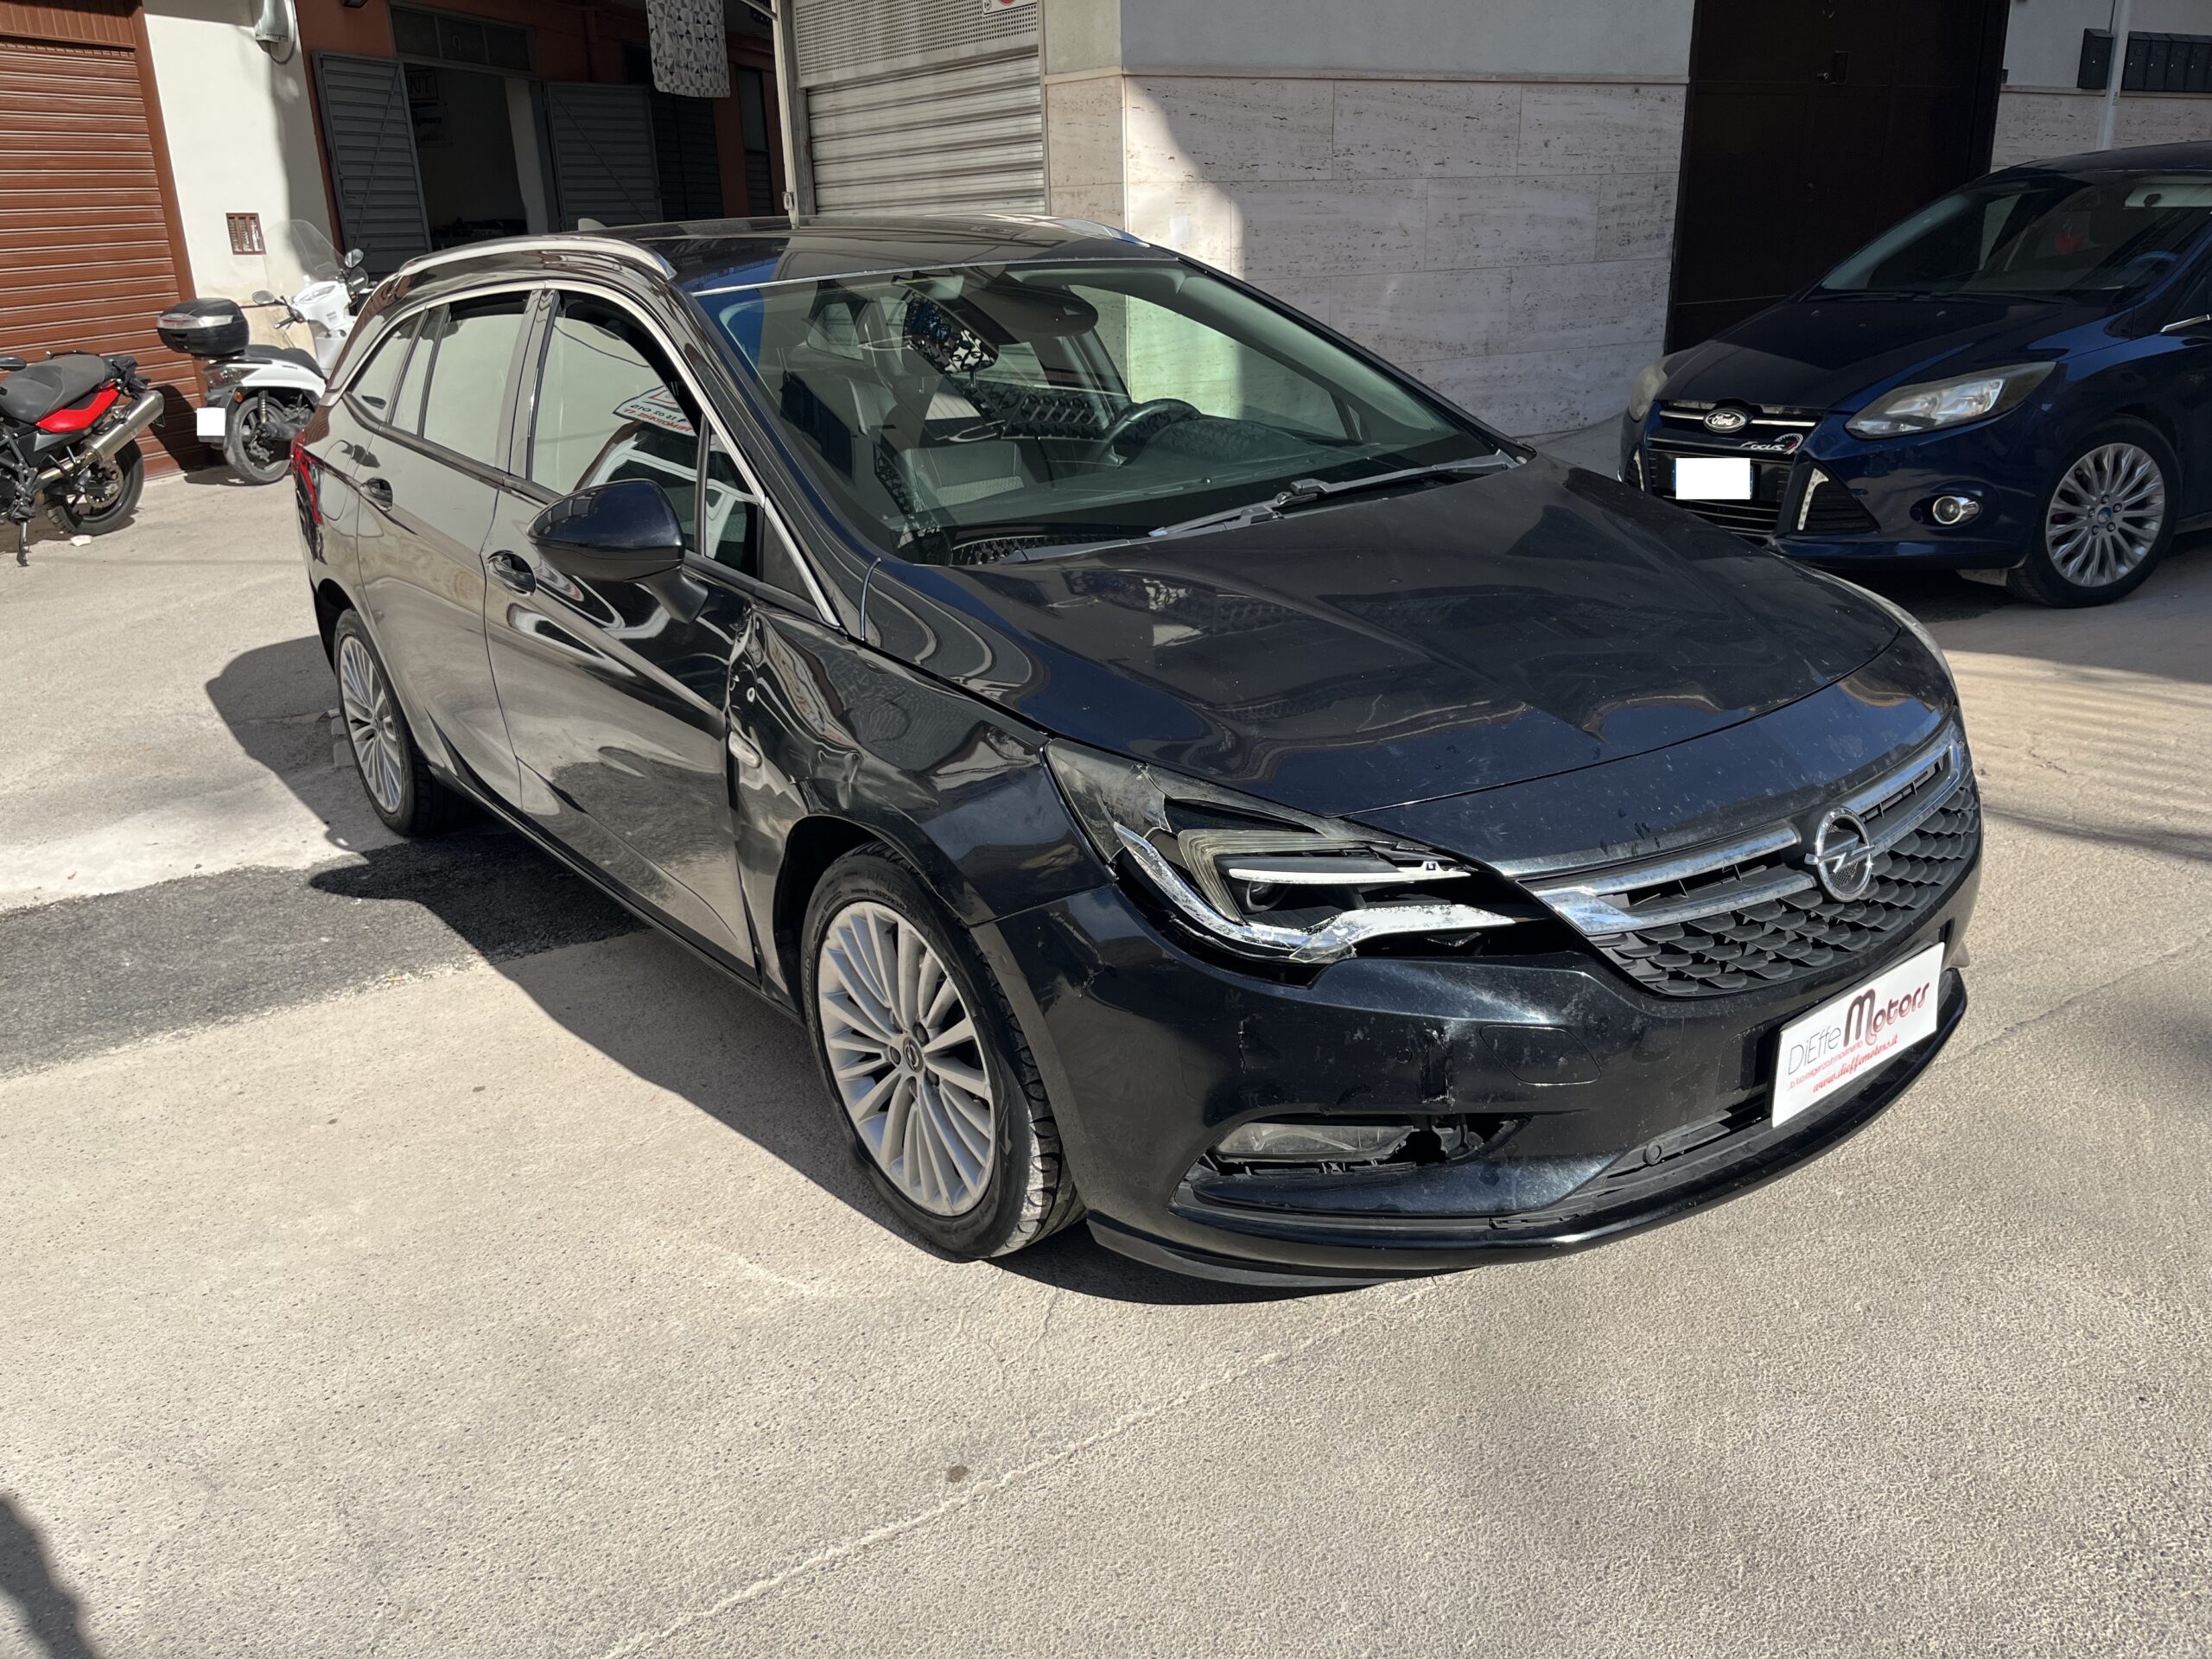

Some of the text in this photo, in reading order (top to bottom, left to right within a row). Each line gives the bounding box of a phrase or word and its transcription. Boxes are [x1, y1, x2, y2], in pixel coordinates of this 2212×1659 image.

[1711, 413, 1736, 426] Ford
[1789, 982, 1930, 1075] DiEffe Motors
[1812, 1034, 1898, 1092] www.dieffemotors.it
